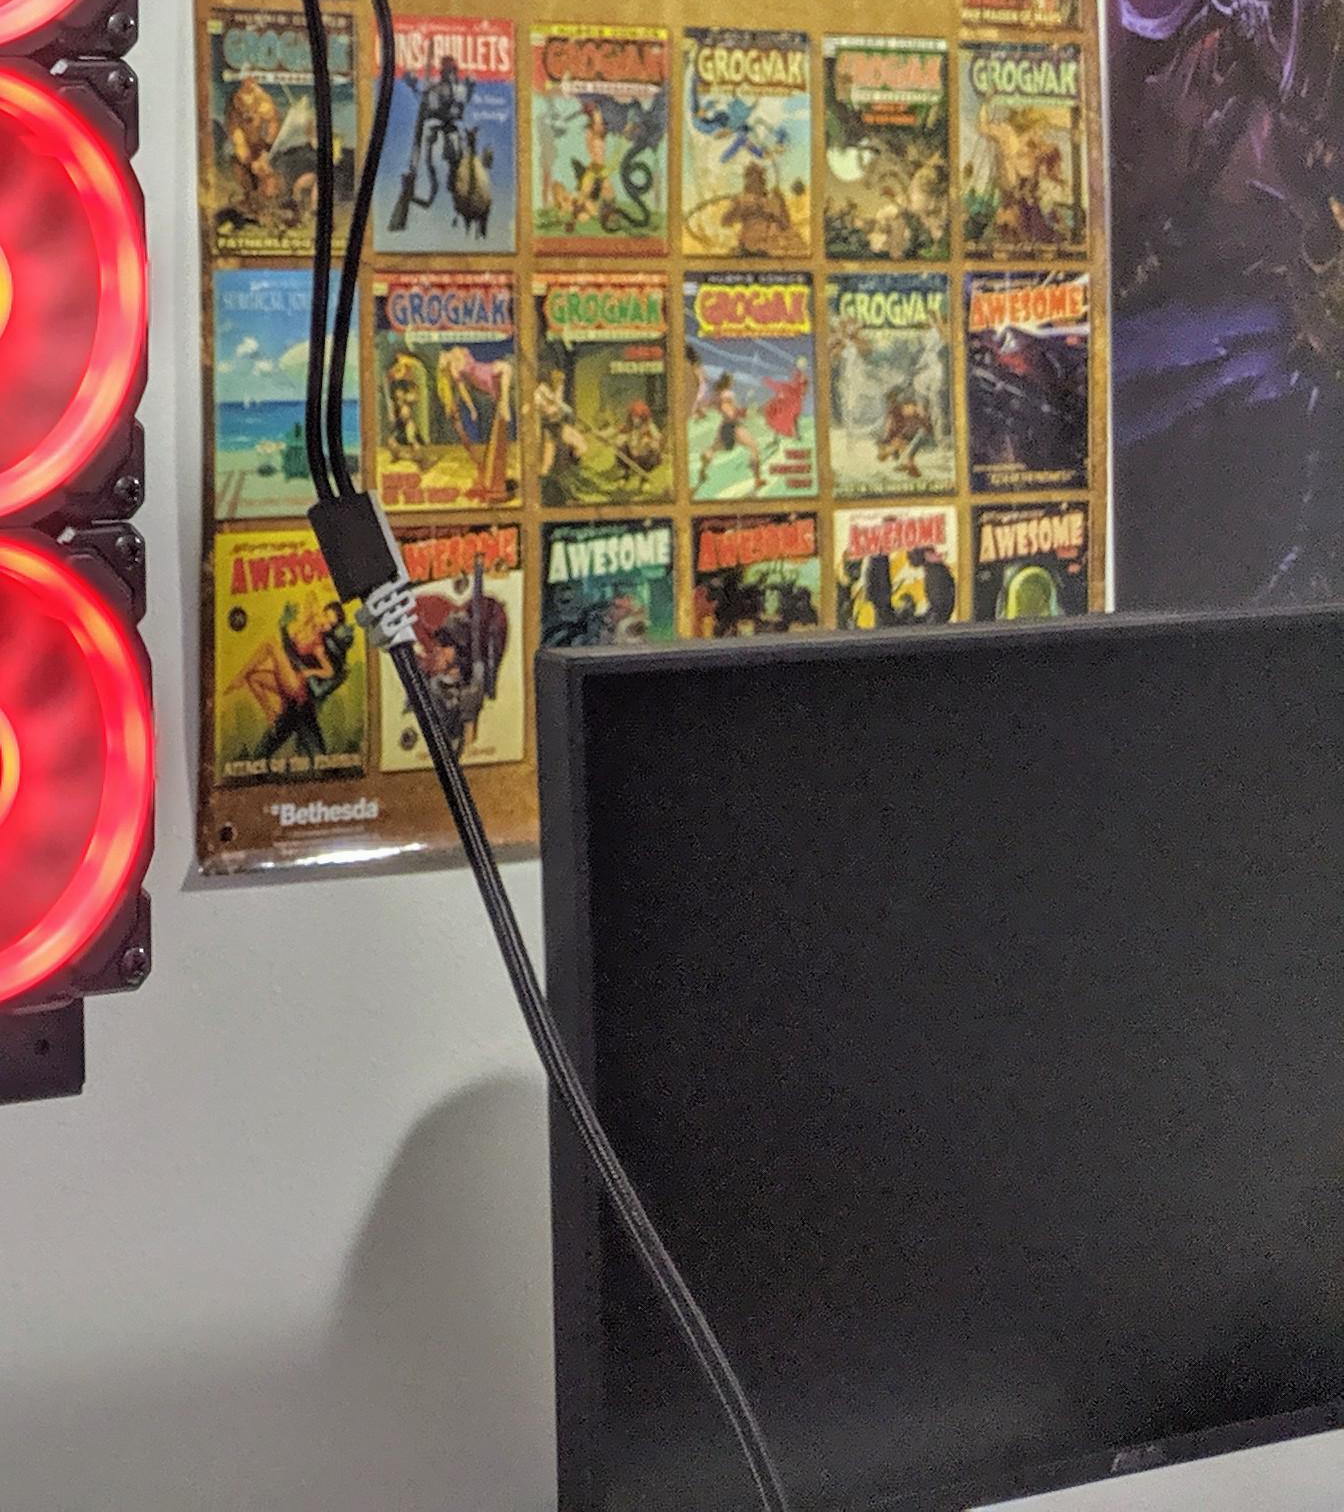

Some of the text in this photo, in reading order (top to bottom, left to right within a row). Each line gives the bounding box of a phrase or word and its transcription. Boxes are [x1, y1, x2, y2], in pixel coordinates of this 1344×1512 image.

[697, 48, 804, 84] GROGNAK
[972, 59, 1077, 94] GROGNAK
[389, 288, 510, 326] GROGNAK
[548, 289, 662, 326] GROGNAK
[838, 292, 944, 325] GROGNAK
[969, 286, 1084, 330] AWESOME
[404, 527, 519, 581] WESOME
[548, 525, 672, 583] AWESOME
[698, 518, 816, 572] AWESOME
[846, 513, 947, 560] AWESOME
[980, 511, 1084, 563] AWESOME
[231, 552, 329, 595] AWESOM
[279, 797, 379, 827] Bethesda
